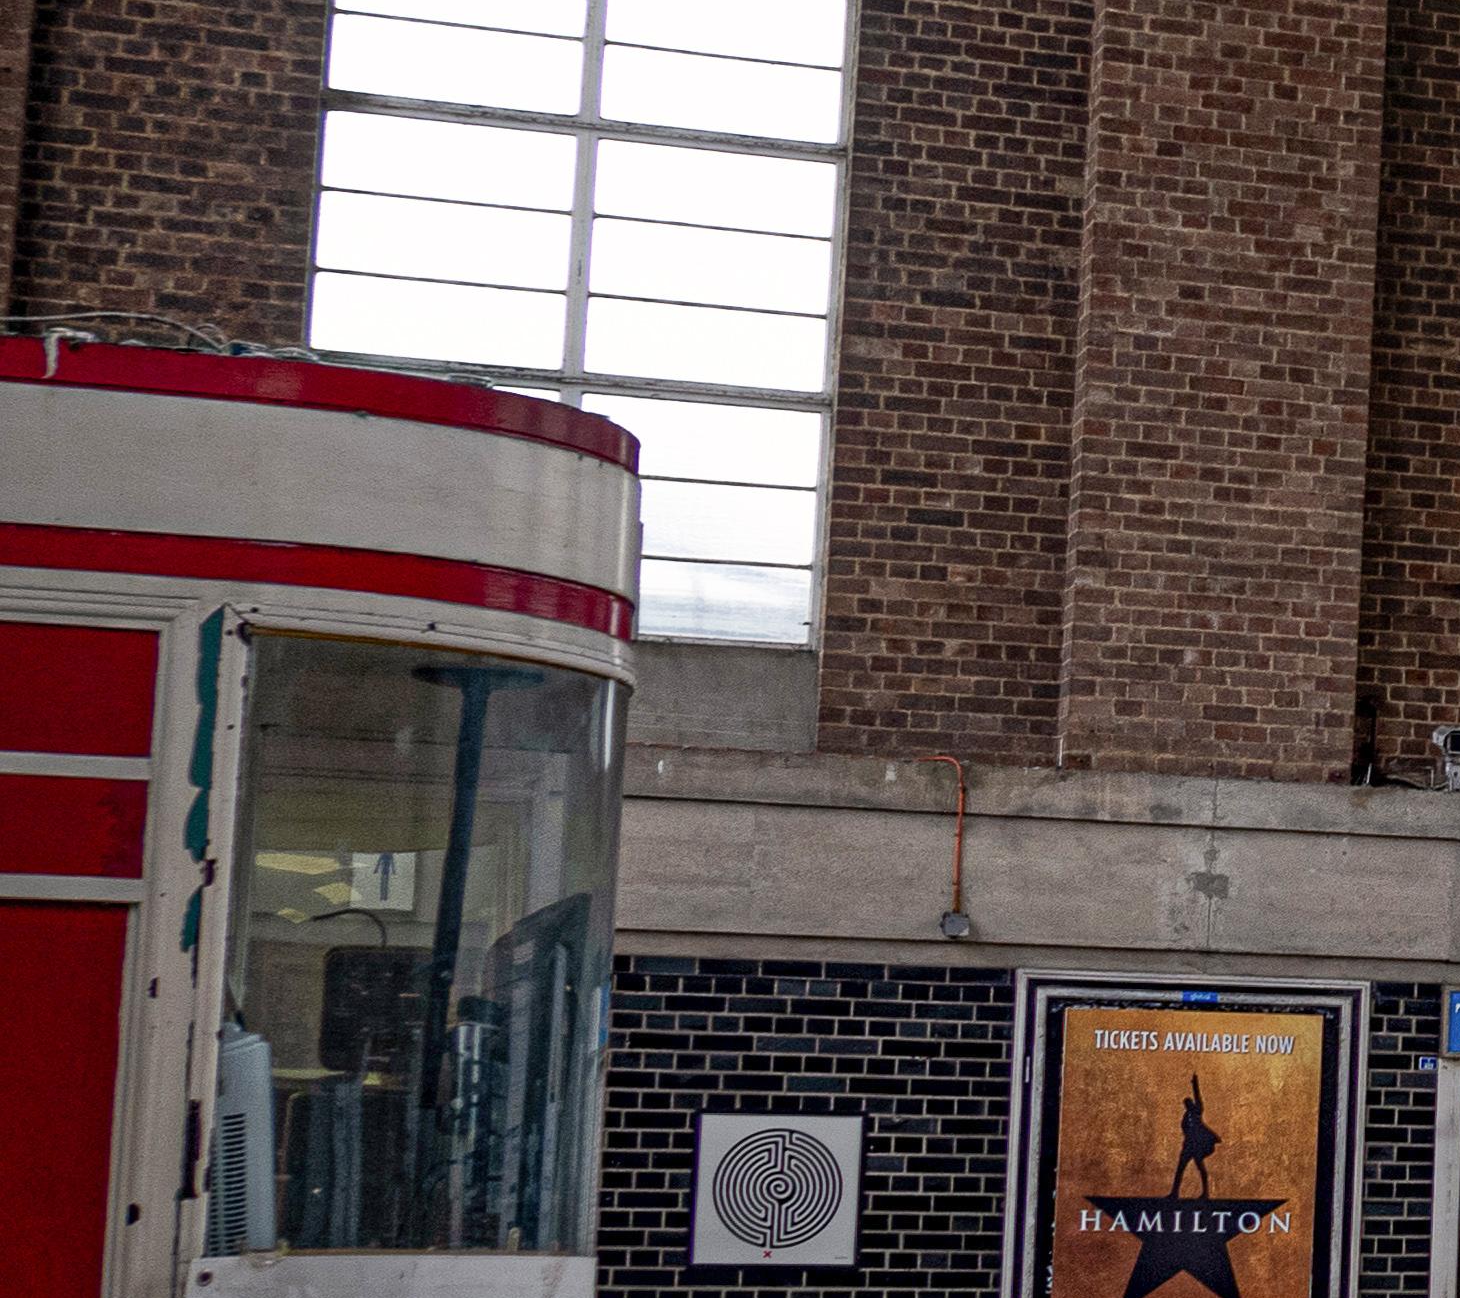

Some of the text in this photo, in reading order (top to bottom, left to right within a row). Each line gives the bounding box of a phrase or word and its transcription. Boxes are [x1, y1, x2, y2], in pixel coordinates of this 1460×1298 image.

[1094, 1029, 1294, 1054] TICKETS AVAILABLE NOW
[1079, 1209, 1292, 1234] HAMILTON
